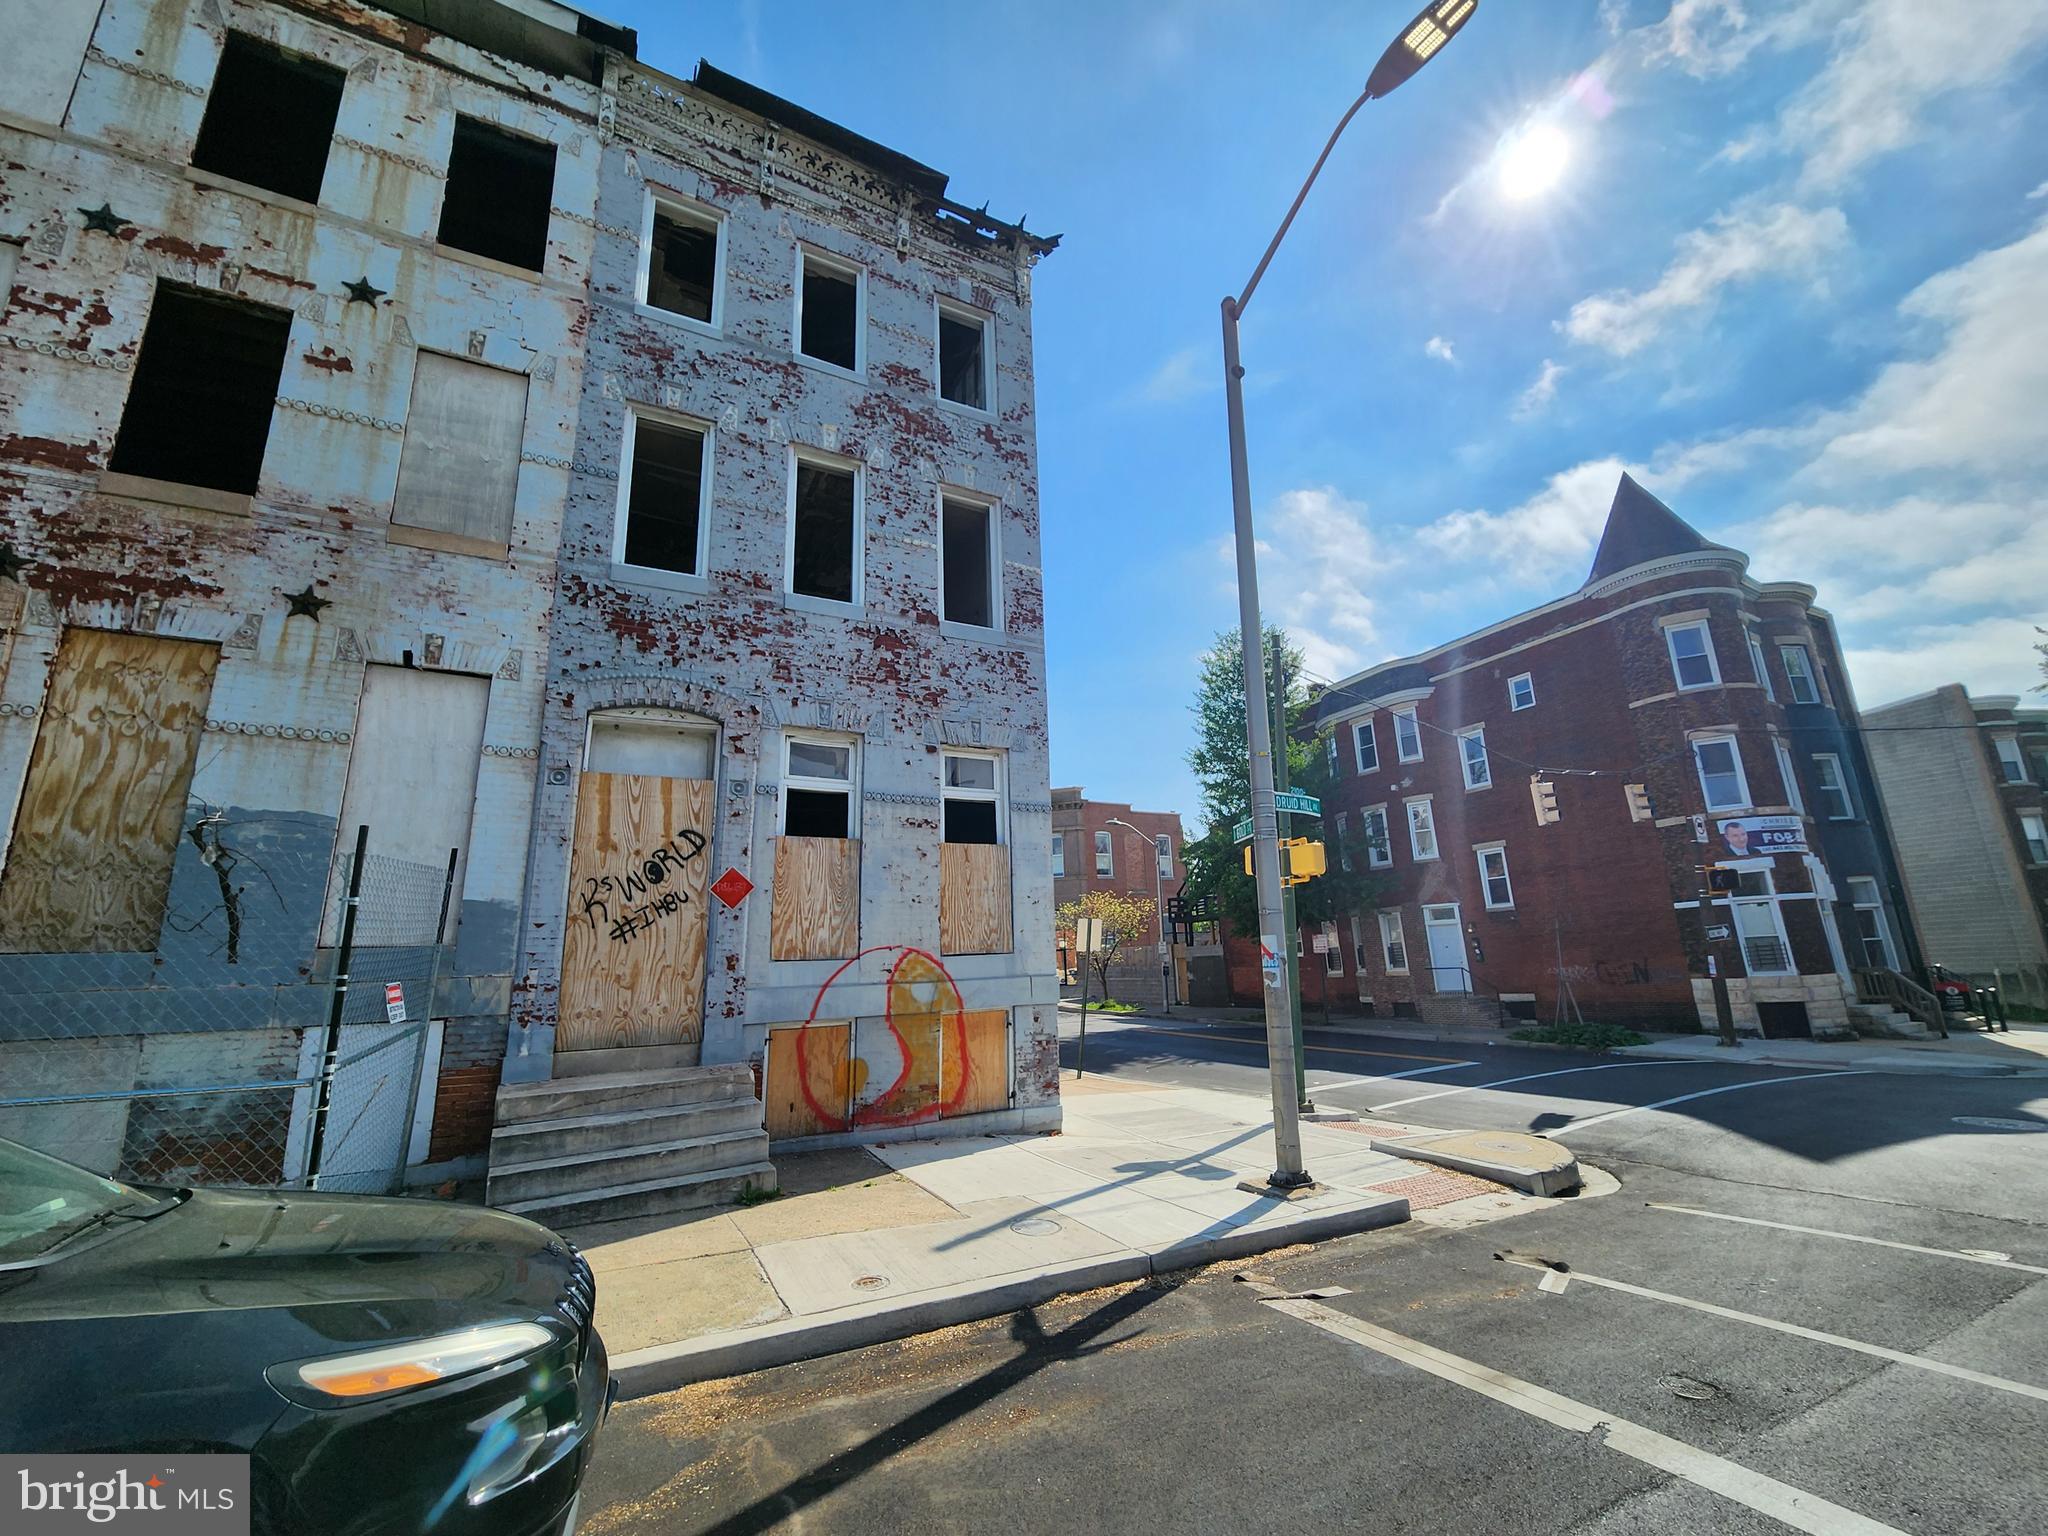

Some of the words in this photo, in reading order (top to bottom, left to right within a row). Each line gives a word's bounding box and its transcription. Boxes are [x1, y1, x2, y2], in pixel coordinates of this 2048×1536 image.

[1276, 796, 1299, 809] DRUID
[1300, 799, 1312, 811] HILL
[615, 829, 706, 902] WORLD
